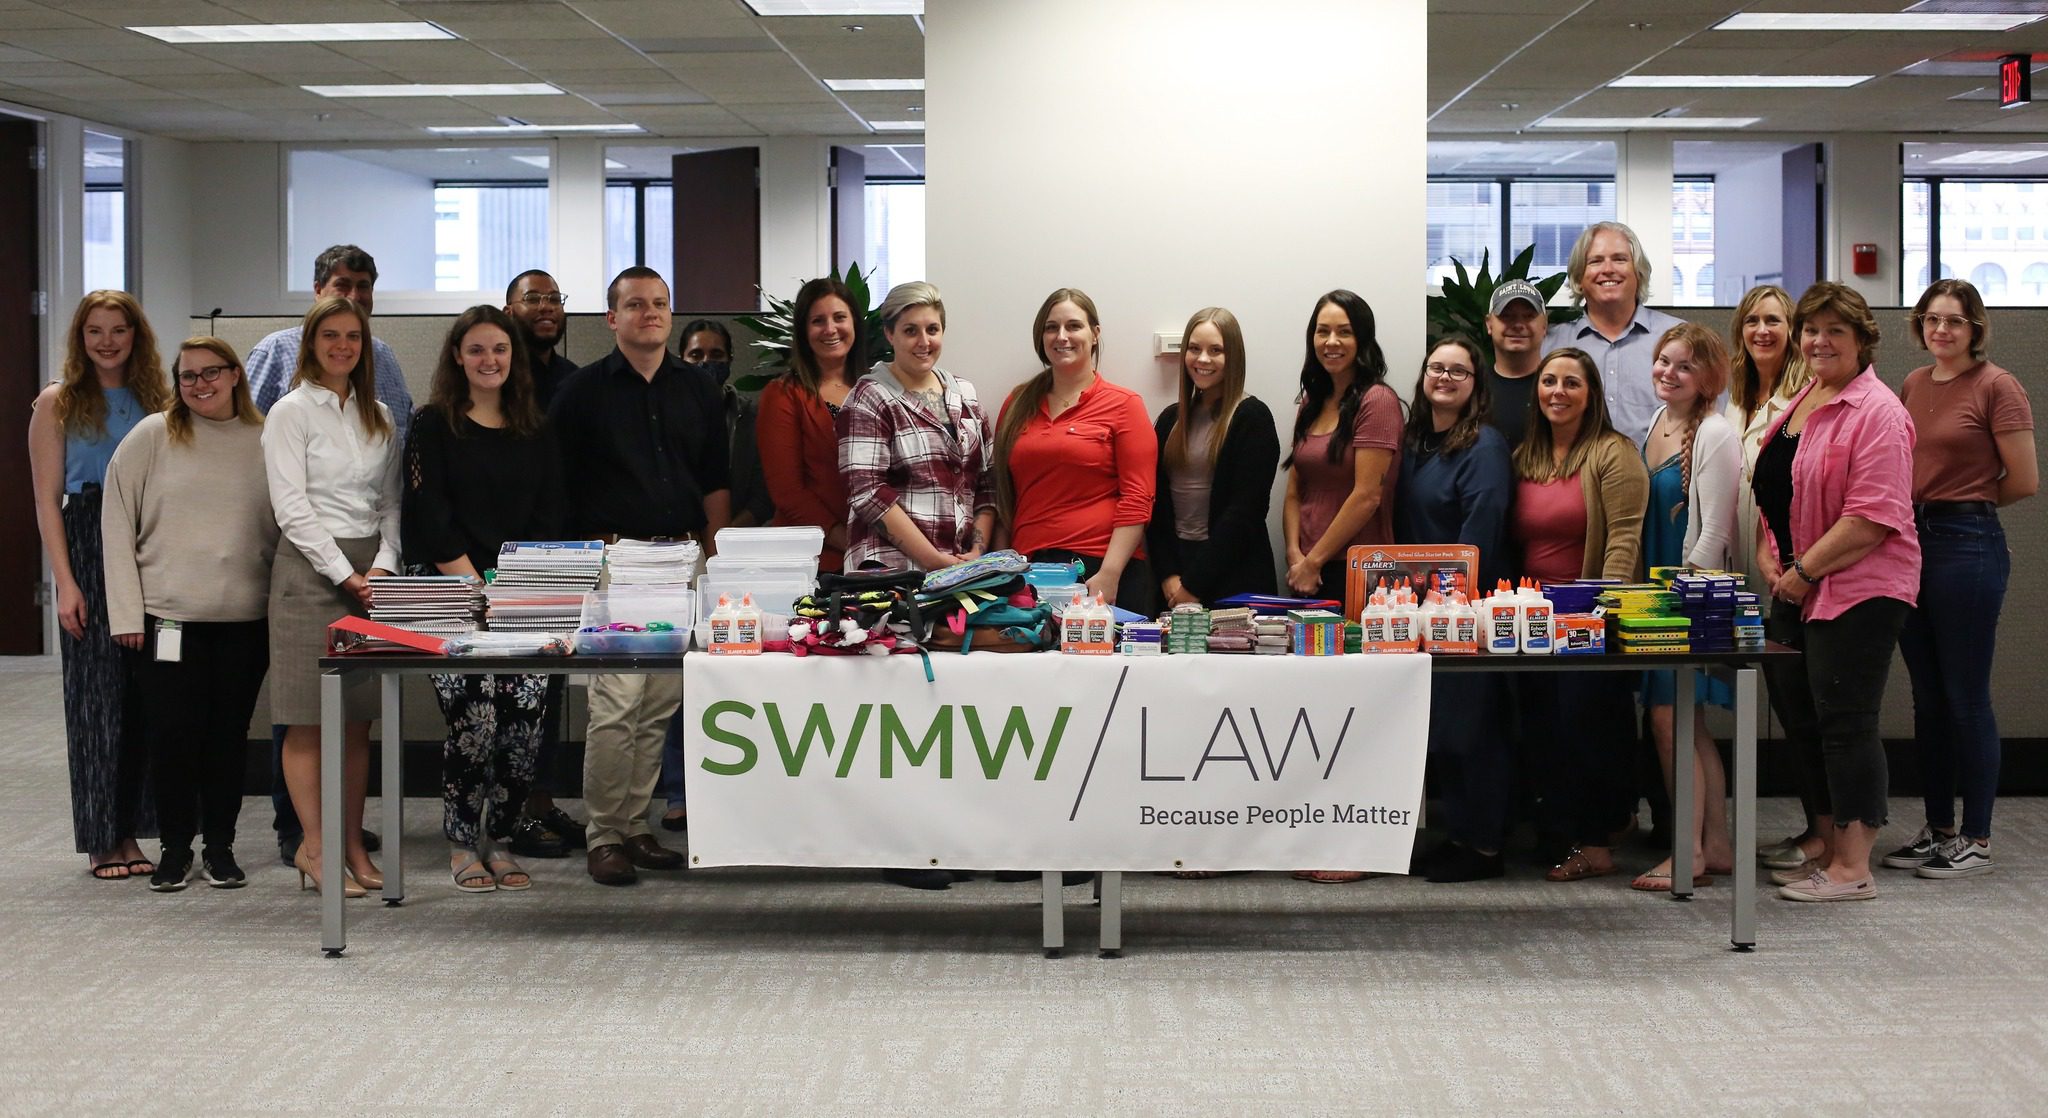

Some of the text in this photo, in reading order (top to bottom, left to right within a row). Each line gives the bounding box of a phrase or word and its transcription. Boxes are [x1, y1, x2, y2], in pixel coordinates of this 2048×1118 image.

[1499, 283, 1536, 296] SAINT LOUIS
[1363, 561, 1393, 569] ELMER'S
[1568, 630, 1577, 638] 30
[699, 699, 1073, 781] SWMW
[1140, 705, 1355, 782] LAW
[1139, 804, 1411, 828] Because People Matter
